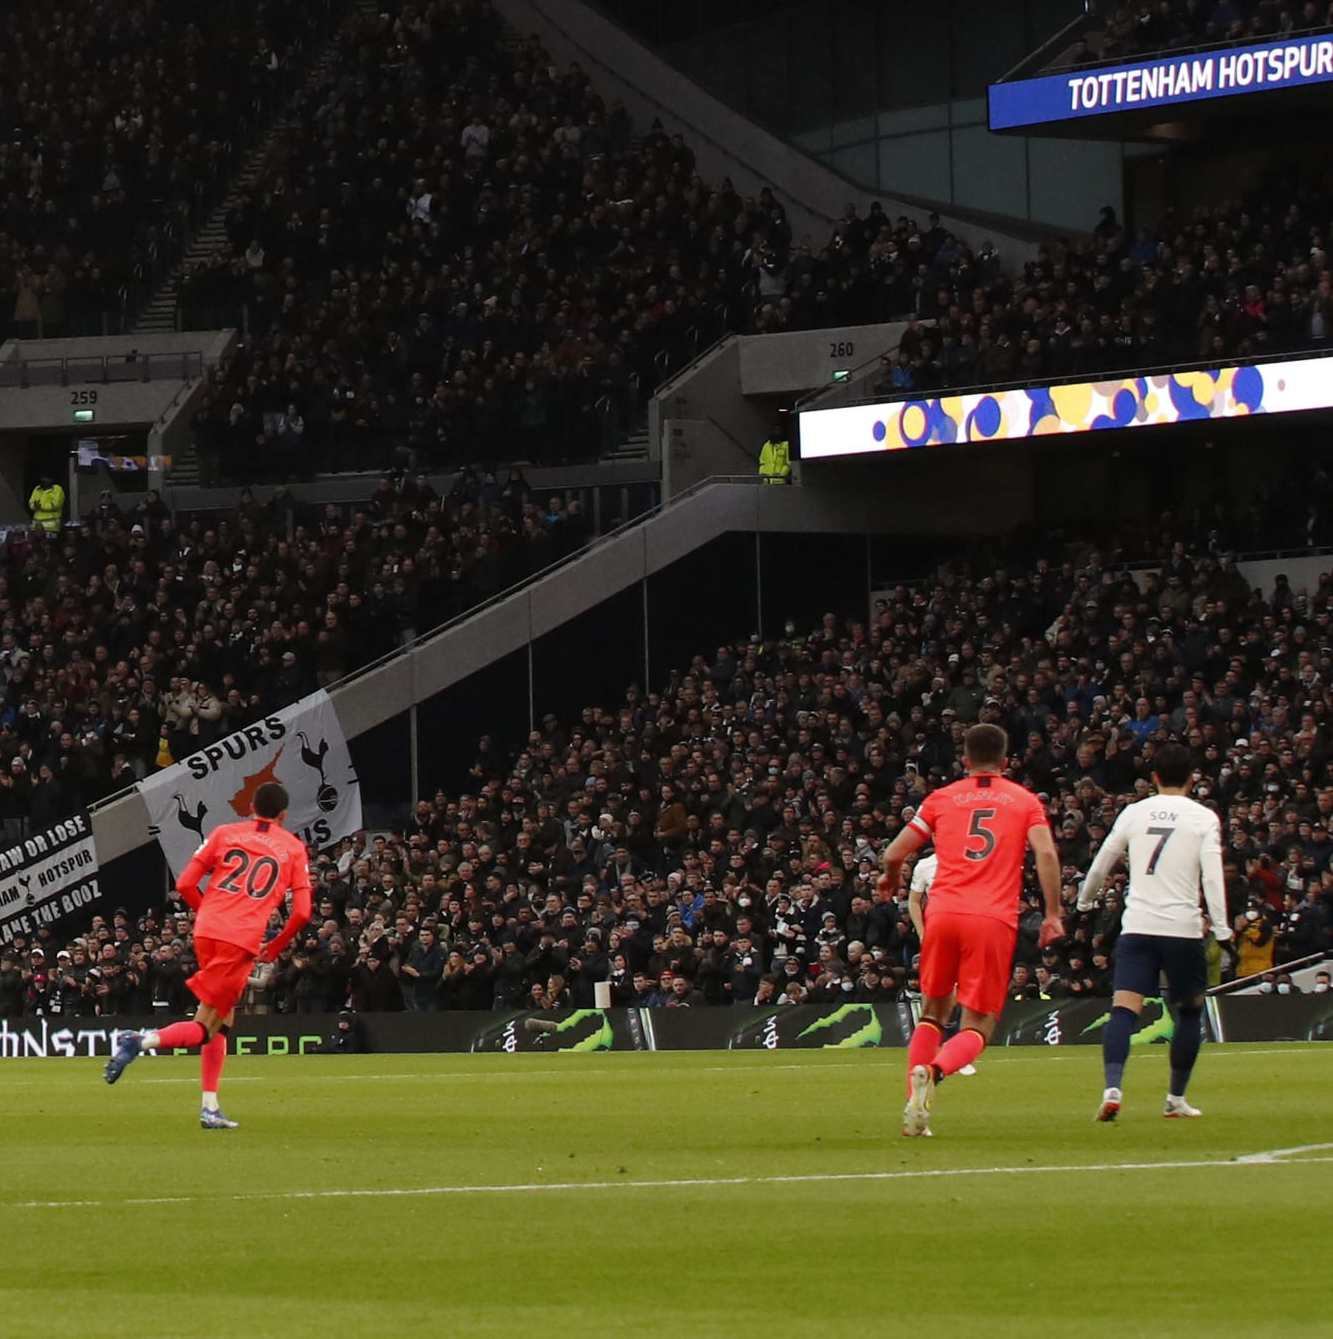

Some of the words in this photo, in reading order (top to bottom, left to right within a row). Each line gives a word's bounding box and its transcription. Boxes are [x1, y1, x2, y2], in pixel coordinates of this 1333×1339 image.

[1068, 58, 1213, 110] TOTTENHAM
[1217, 41, 1333, 90] HOTSPUR
[829, 342, 854, 358] 260
[70, 390, 98, 405] 259
[187, 716, 286, 780] SPURS
[23, 834, 49, 858] OR
[46, 814, 87, 847] LOSE
[964, 808, 996, 862] 5
[1149, 811, 1179, 822] SON
[37, 848, 94, 888] HOTSPUR
[1145, 826, 1176, 876] 7
[216, 847, 280, 900] 20
[31, 900, 62, 926] THE
